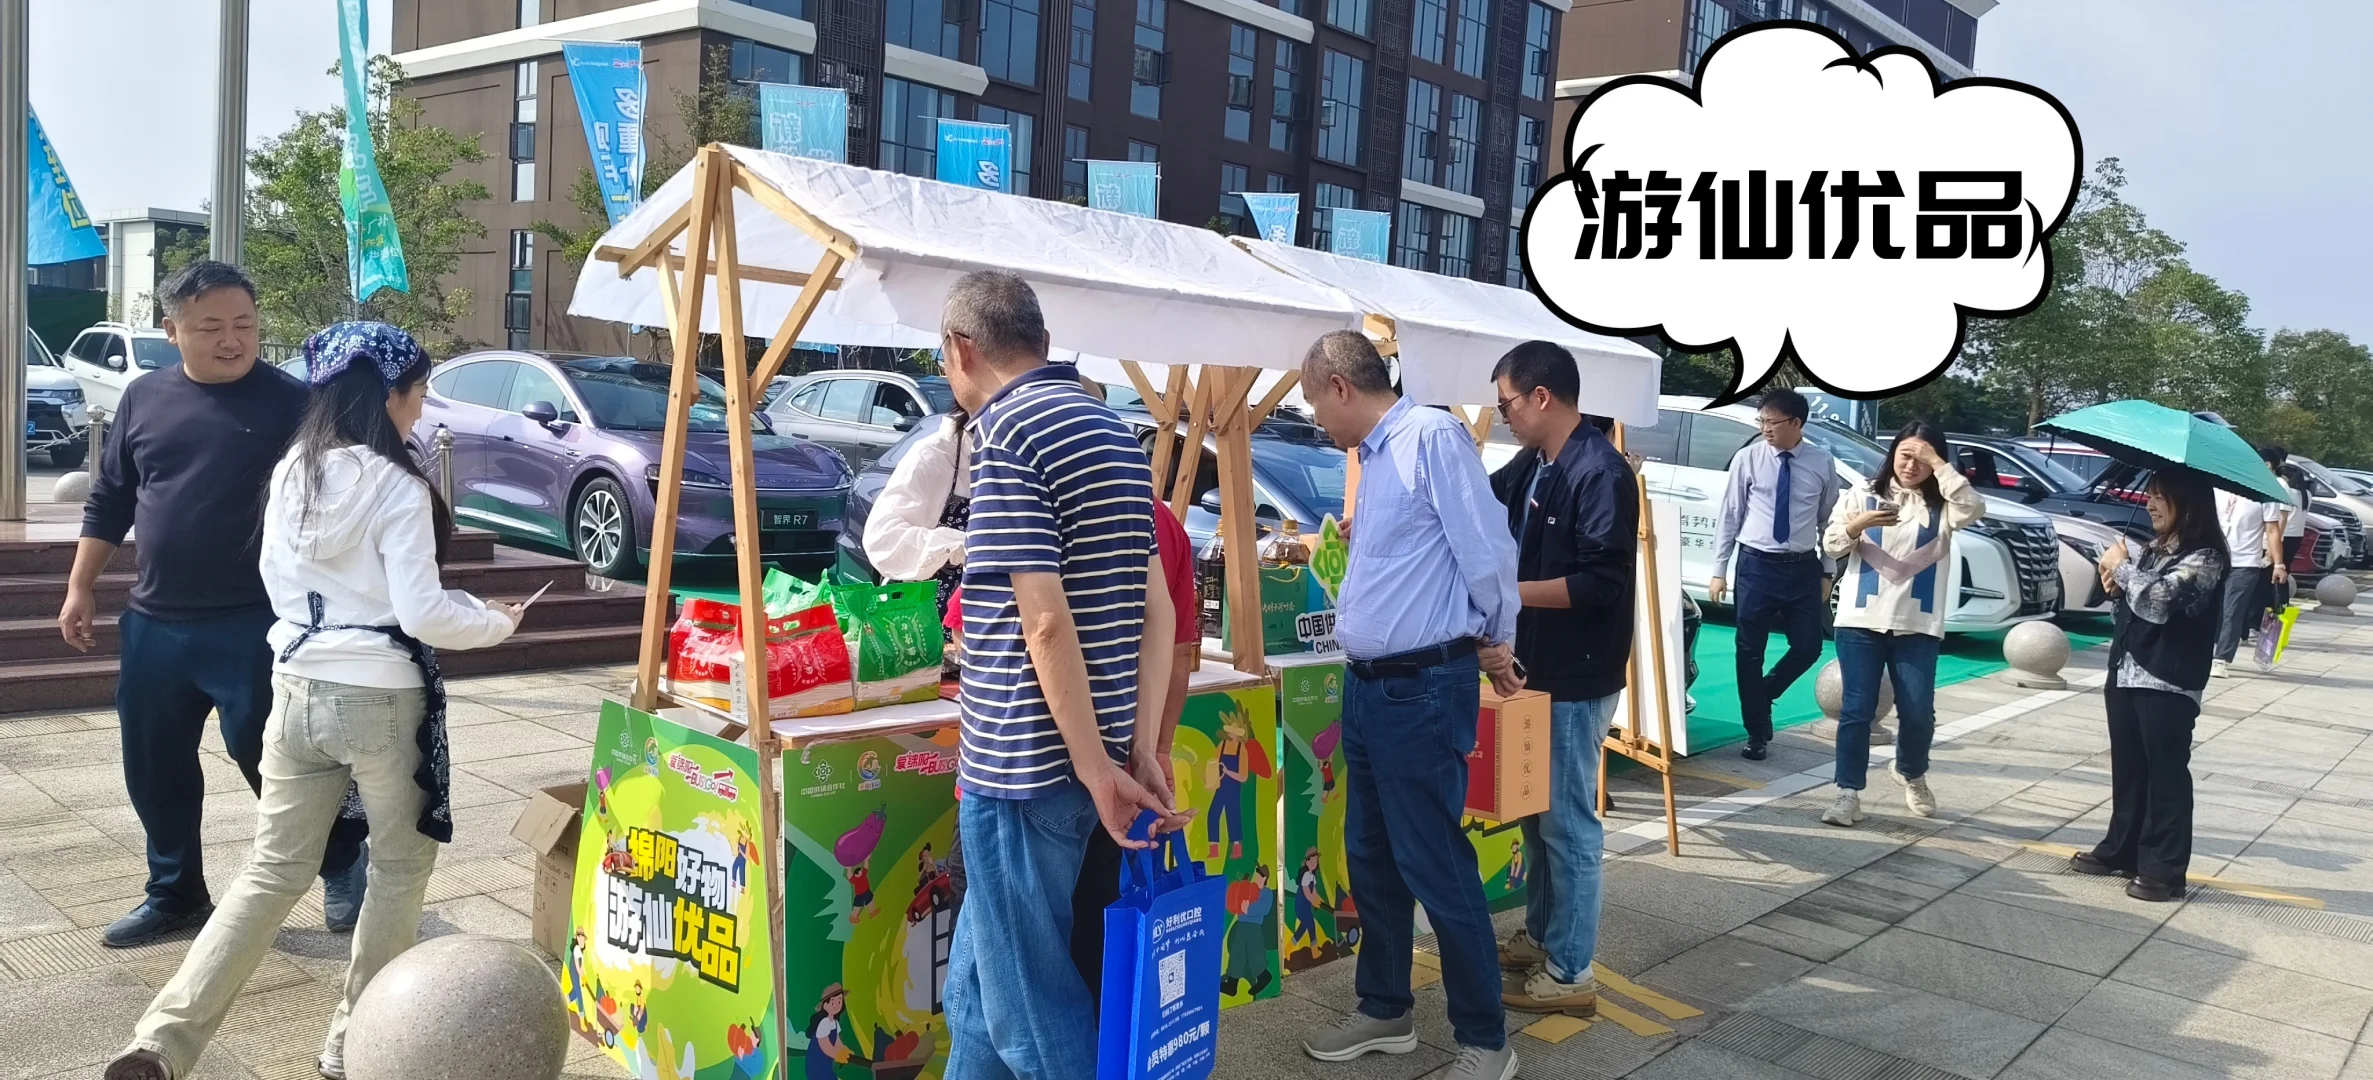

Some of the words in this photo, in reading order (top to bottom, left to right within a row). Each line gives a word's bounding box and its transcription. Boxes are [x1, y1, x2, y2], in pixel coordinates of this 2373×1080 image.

[773, 514, 791, 525] 智界
[793, 514, 809, 525] R7
[1315, 640, 1343, 654] CHIN
[626, 828, 728, 911] 绵阳好物
[608, 875, 740, 987] 游仙优品
